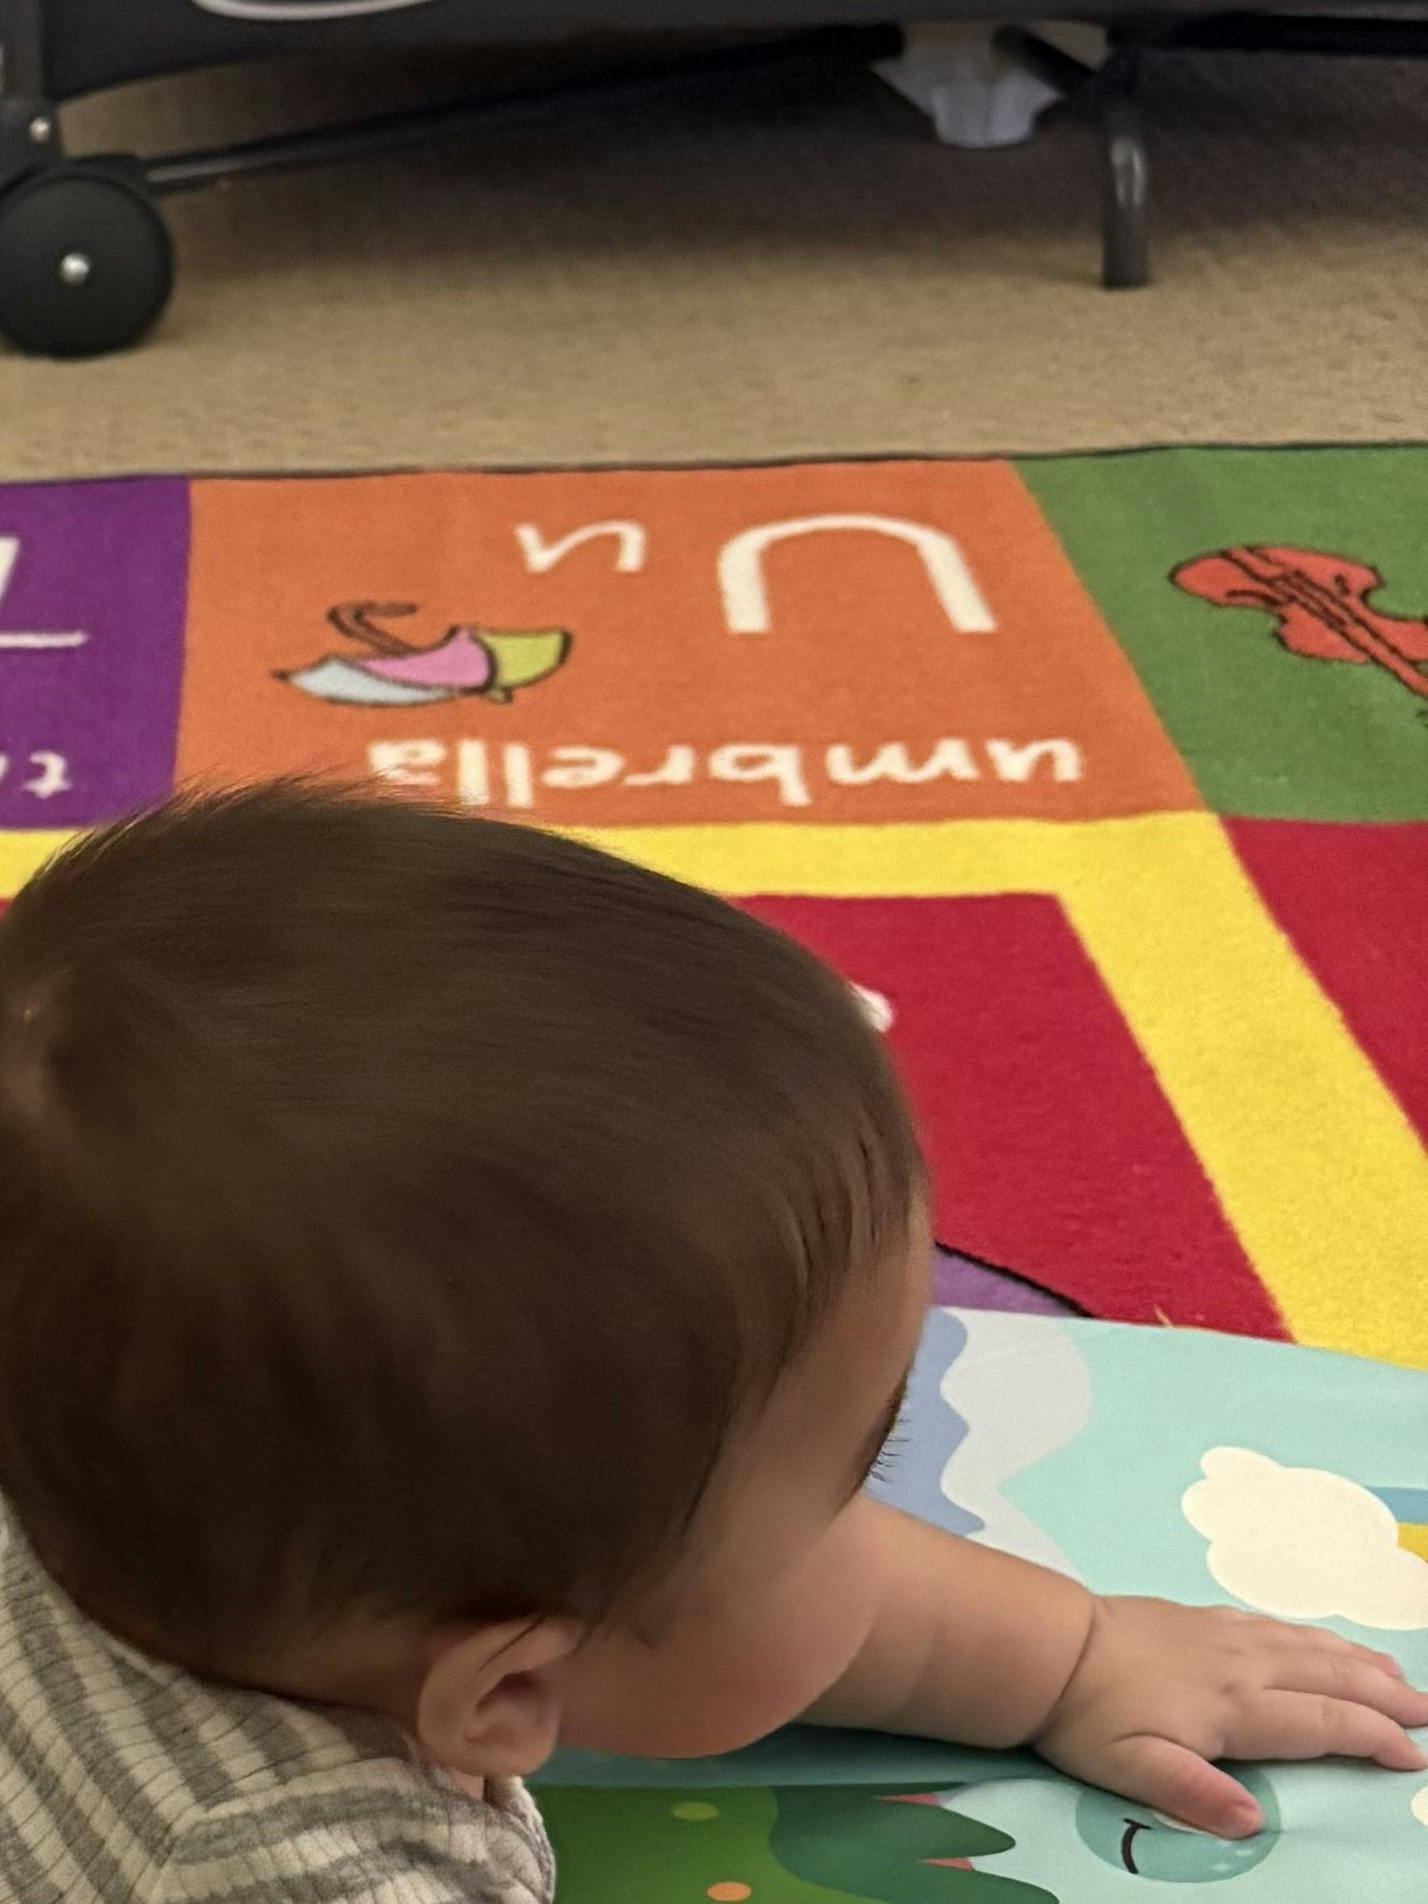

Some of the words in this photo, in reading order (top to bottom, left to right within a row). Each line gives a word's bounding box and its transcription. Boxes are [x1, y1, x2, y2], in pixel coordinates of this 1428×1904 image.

[513, 519, 645, 573] u
[716, 513, 997, 634] U
[366, 735, 1083, 809] umbrella
